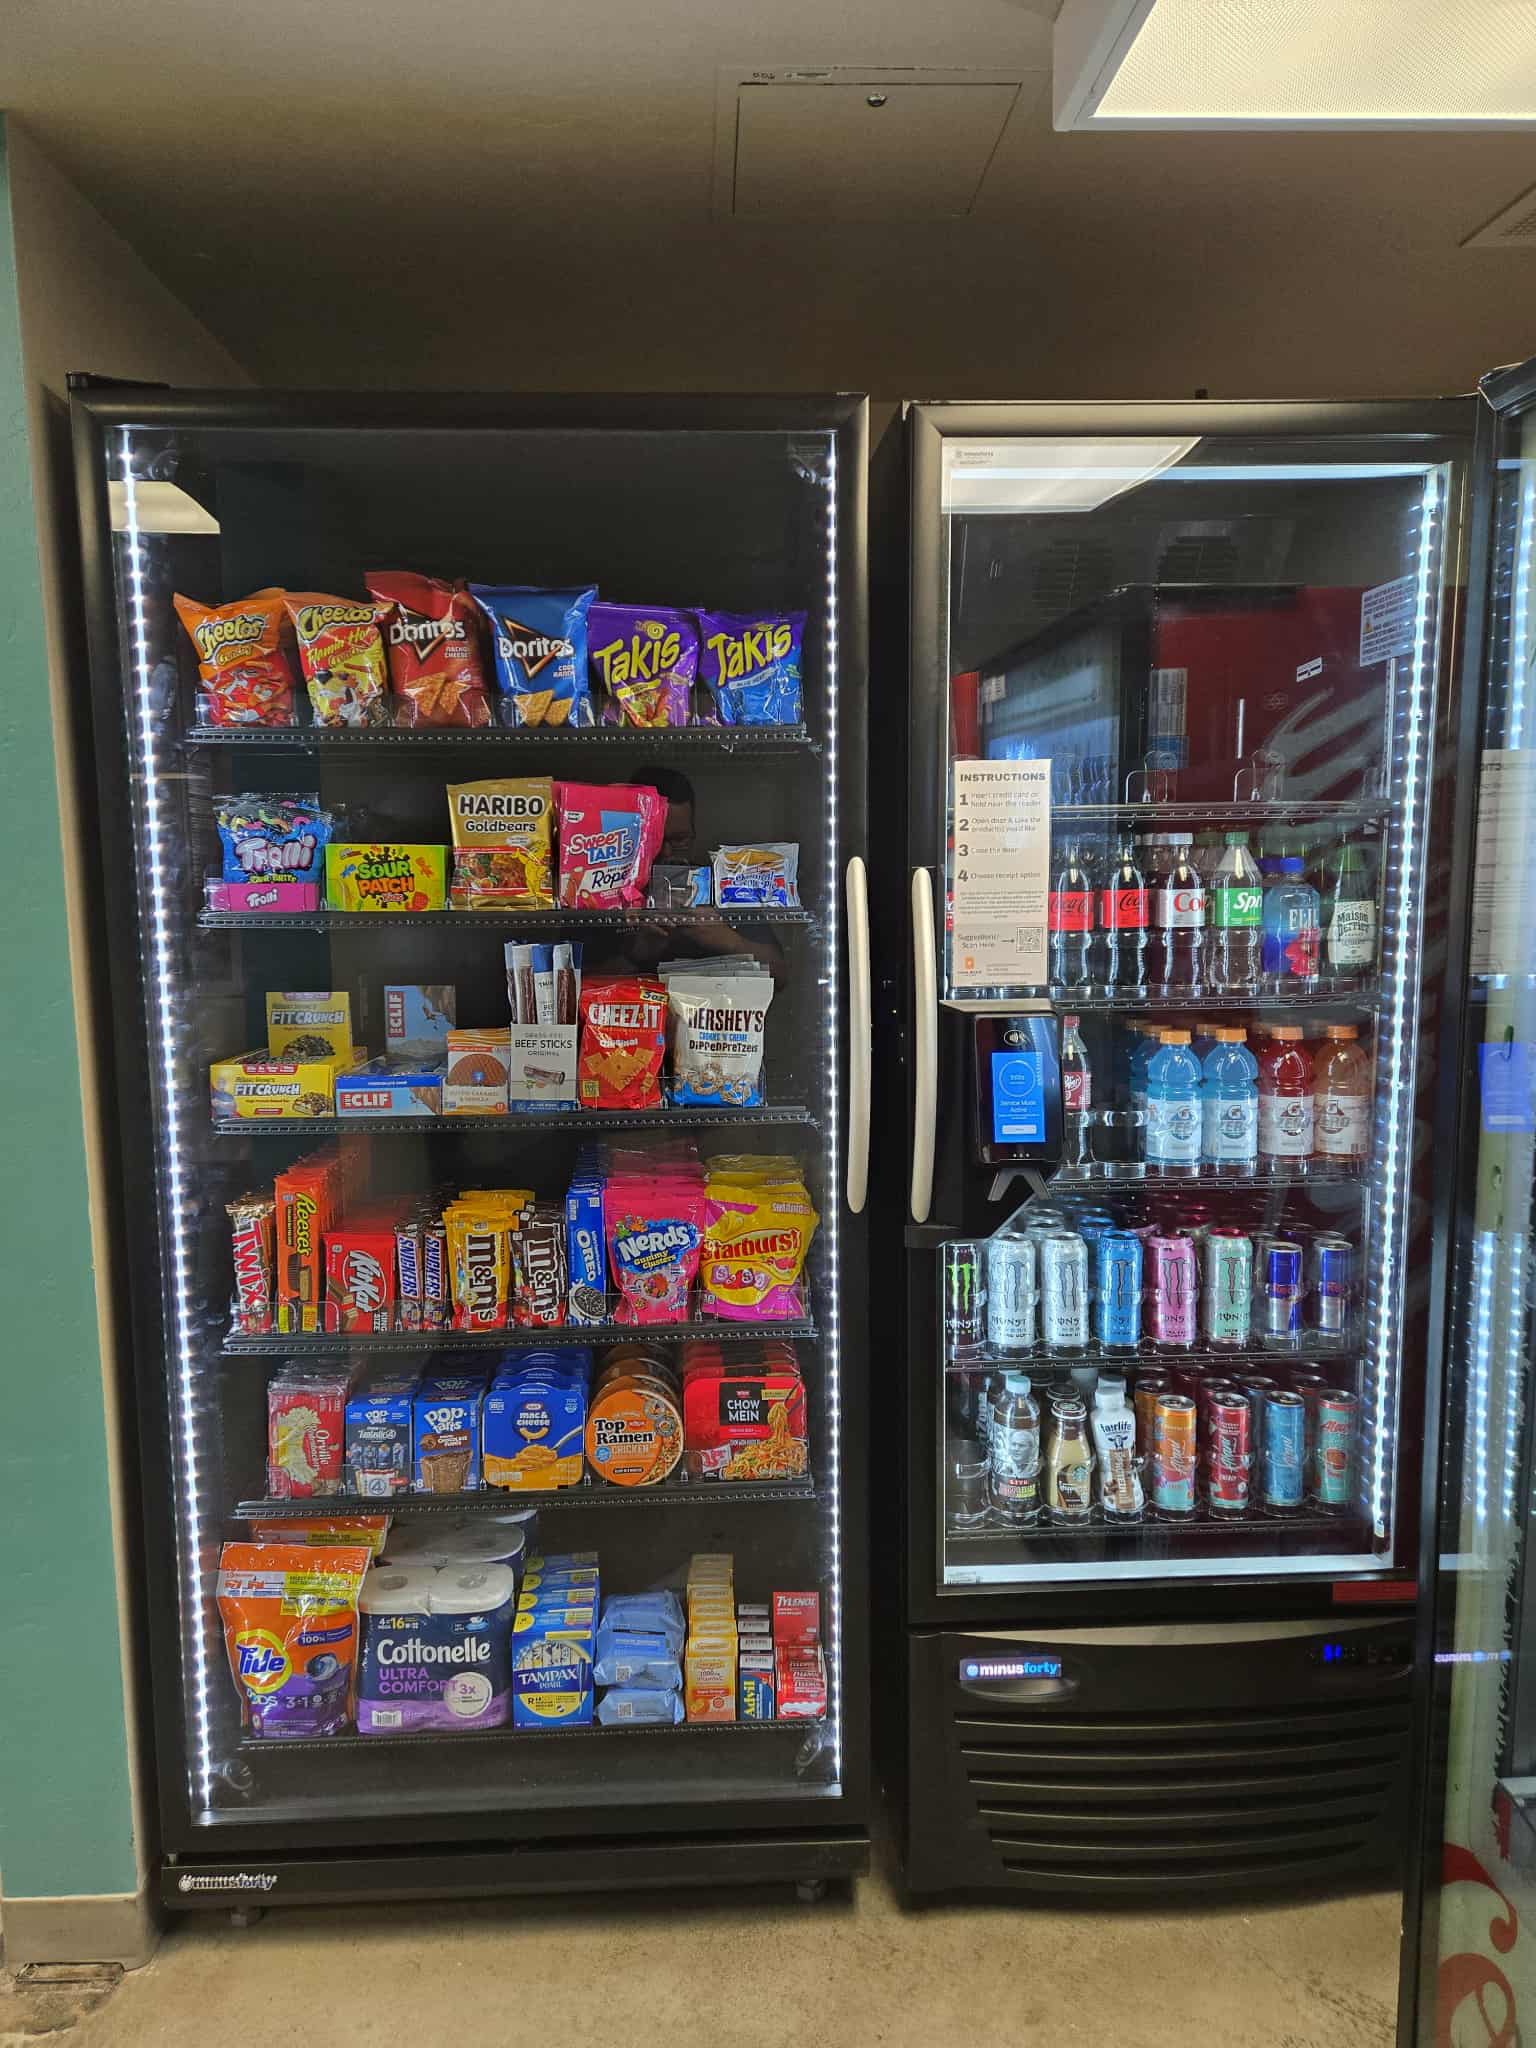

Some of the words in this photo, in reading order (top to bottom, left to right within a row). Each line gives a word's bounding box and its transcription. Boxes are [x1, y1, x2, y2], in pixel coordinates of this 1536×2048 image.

[298, 607, 375, 643] Cheetos
[390, 619, 466, 644] Doritos
[499, 636, 574, 659] Doritos
[707, 623, 793, 688] Takis
[593, 633, 681, 697] Takis
[960, 772, 1046, 782] INSTRUCTIONS
[459, 795, 545, 817] HARIBO
[960, 793, 968, 806] 1
[465, 820, 537, 833] Goldbears
[959, 818, 969, 831] 2
[959, 843, 968, 857] 3
[358, 861, 410, 879] SOUR
[958, 868, 969, 882] 4
[359, 877, 415, 896] PATCH
[246, 887, 278, 908] Trolli
[1337, 910, 1369, 922] Maison
[390, 993, 402, 1026] CLIF
[686, 1007, 764, 1032] HERSHEY'S
[514, 1039, 538, 1049] BEEF
[540, 1039, 573, 1049] STICKS
[352, 1094, 389, 1107] CLIF
[701, 1229, 801, 1261] Starburst
[232, 1219, 263, 1307] TWIX
[576, 1230, 597, 1282] OREO
[399, 1235, 418, 1298] SNICKERS
[425, 1235, 441, 1299] SNICKERS
[727, 1399, 761, 1410] CHOW
[728, 1411, 760, 1422] MEIN
[594, 1419, 625, 1433] Top
[1100, 1420, 1133, 1433] fairlife
[315, 1429, 329, 1465] Orville
[596, 1432, 654, 1445] Ramen
[390, 1615, 405, 1630] 16
[237, 1644, 286, 1675] Tide
[377, 1637, 492, 1666] Cottonelle
[379, 1667, 430, 1681] ULTRA
[518, 1667, 578, 1686] TAMPAX
[979, 1660, 1057, 1676] minusforty
[379, 1680, 459, 1695] COMFORT
